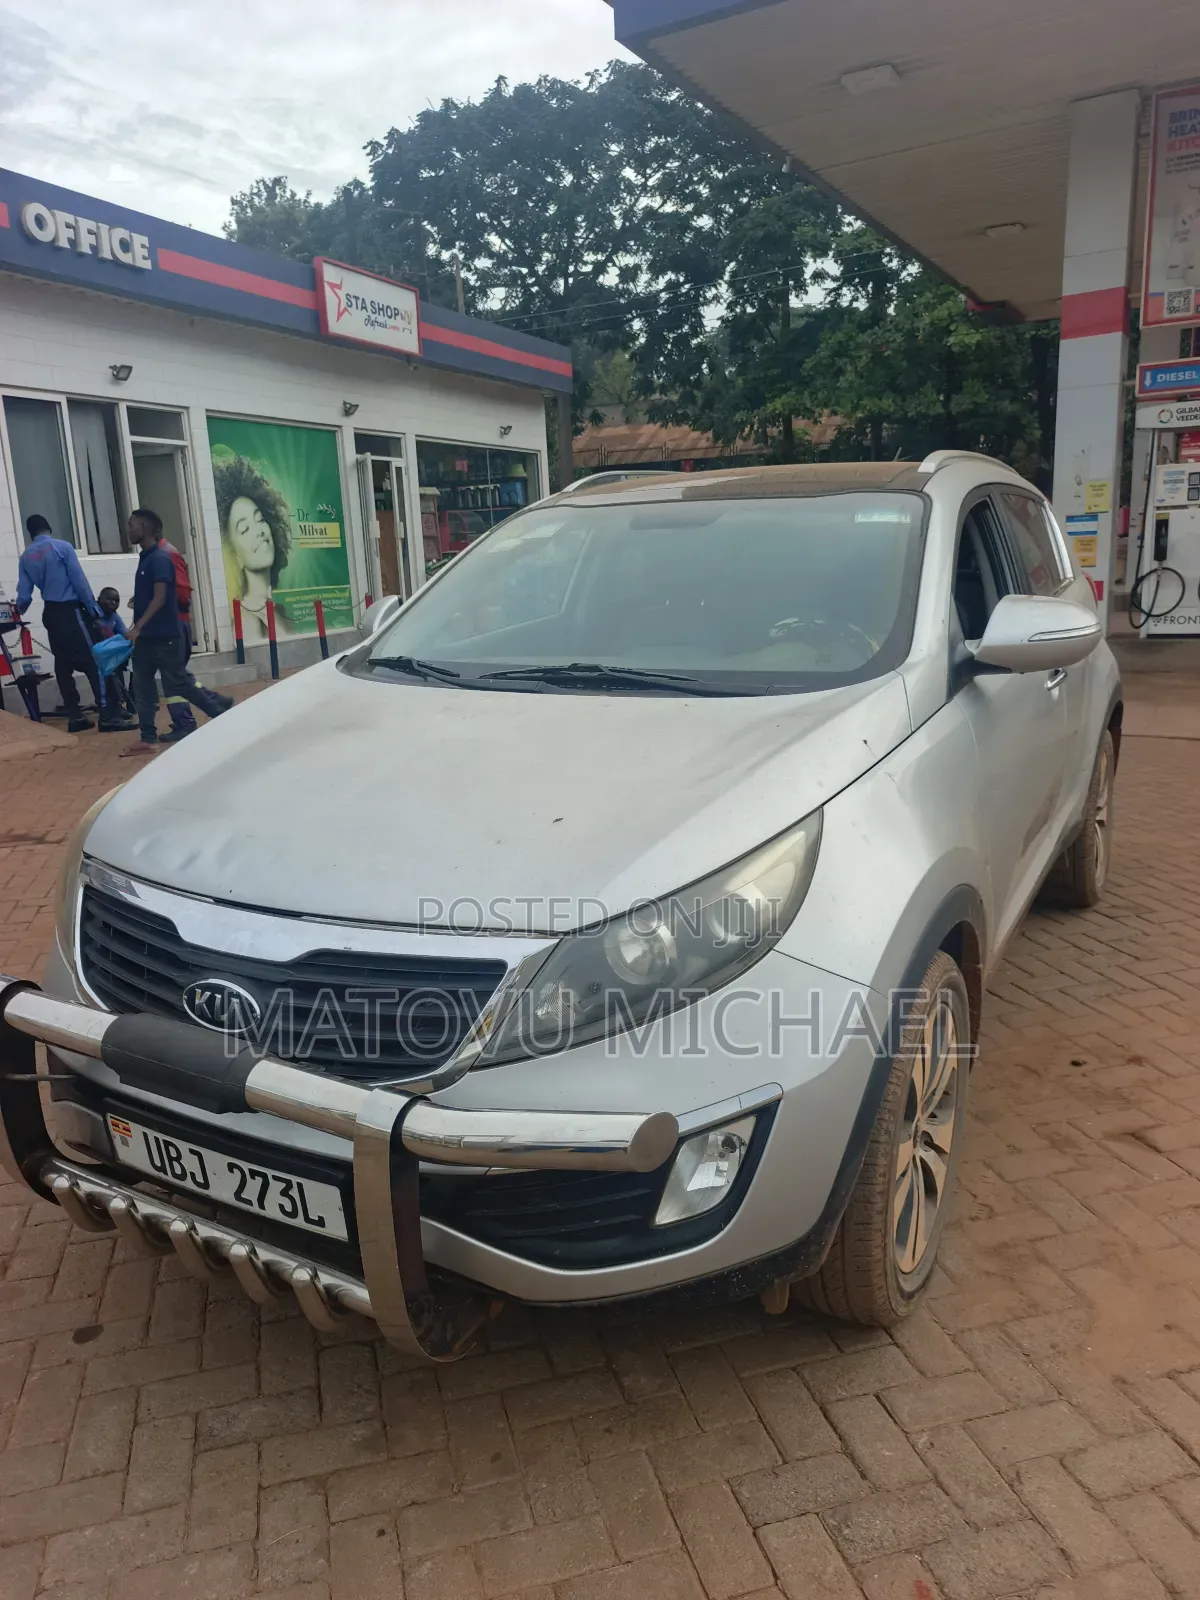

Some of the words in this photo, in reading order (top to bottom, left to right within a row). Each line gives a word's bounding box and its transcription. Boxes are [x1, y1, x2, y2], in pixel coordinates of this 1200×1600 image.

[22, 202, 152, 270] OFFICE
[345, 293, 369, 313] STA
[370, 300, 400, 320] SHOP
[1156, 370, 1199, 383] DIESEL
[297, 508, 309, 521] Dr
[298, 524, 327, 537] Milvat
[194, 988, 243, 1026] KIA
[142, 1131, 211, 1190] UBJ
[227, 1161, 326, 1229] 273L
